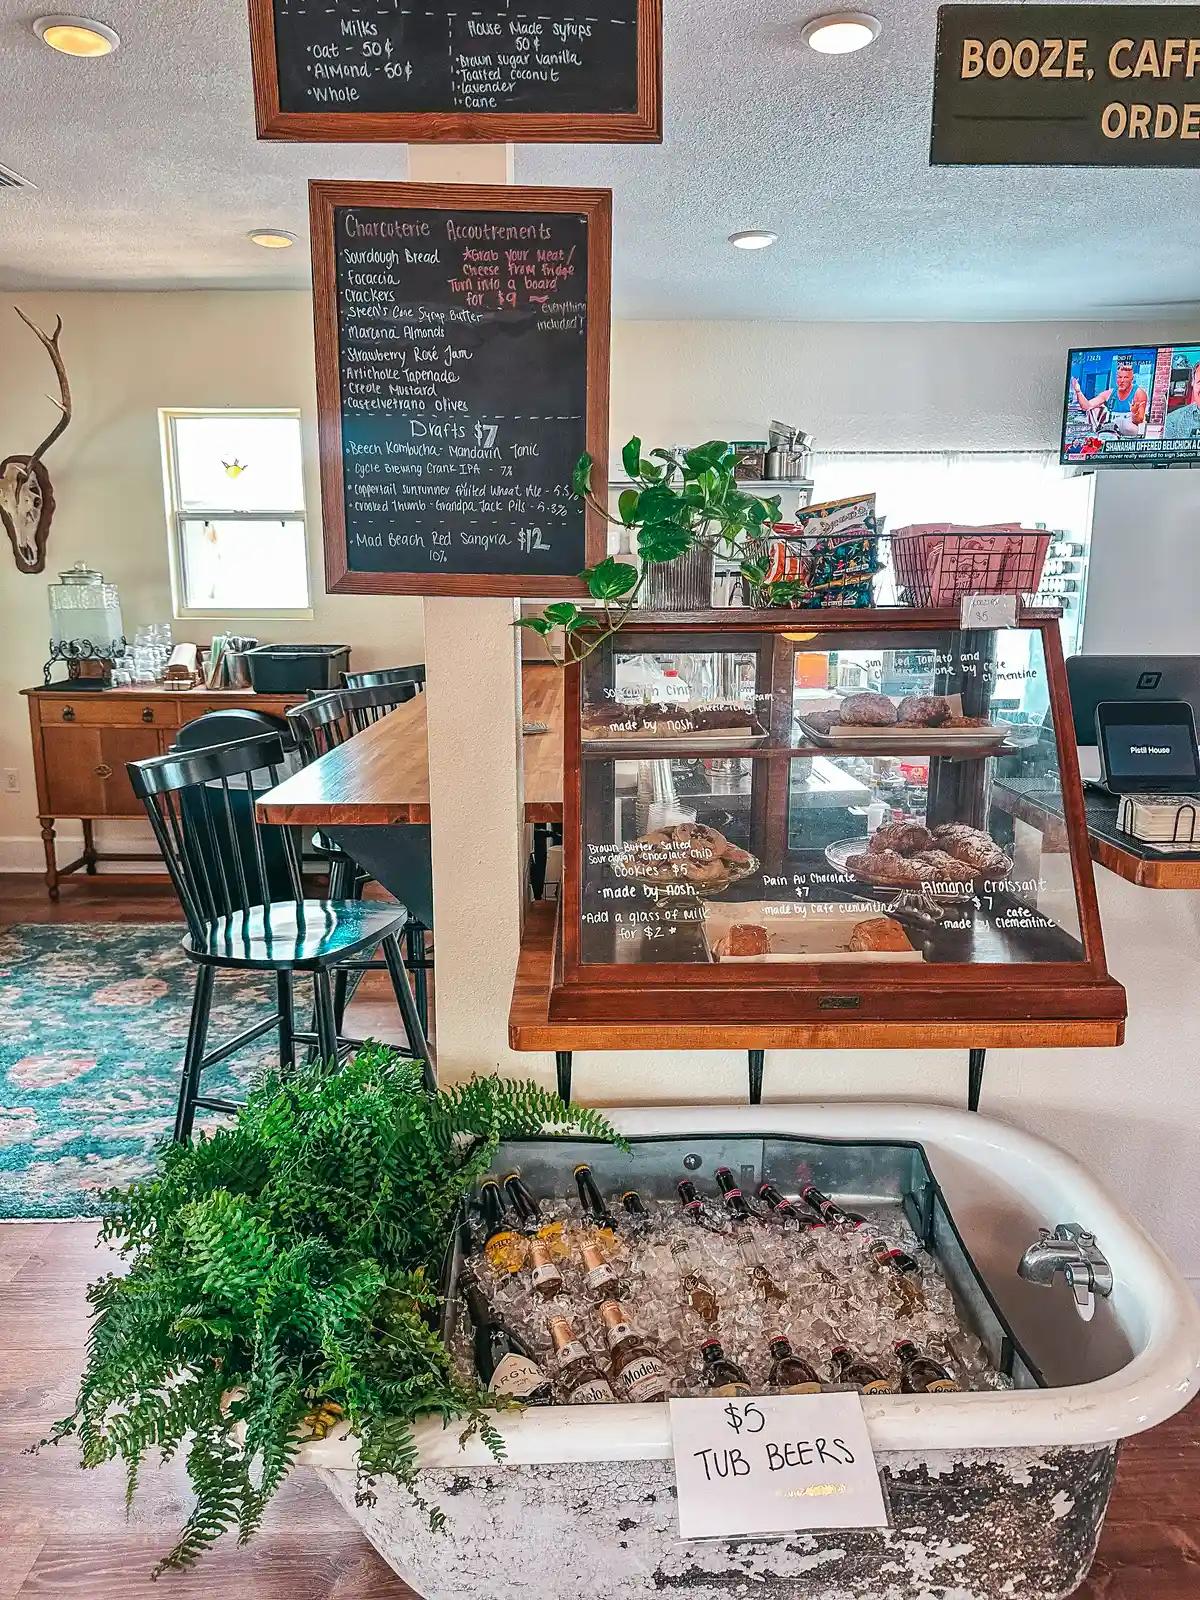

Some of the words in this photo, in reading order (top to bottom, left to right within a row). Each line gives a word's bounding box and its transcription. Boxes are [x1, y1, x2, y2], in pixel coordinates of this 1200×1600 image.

[340, 19, 378, 38] Milks
[467, 20, 502, 37] House
[508, 20, 543, 36] Made
[312, 43, 340, 59] Oat
[459, 54, 493, 68] Brown
[961, 38, 1095, 82] BOOZE,
[312, 86, 360, 102] Whole
[464, 96, 498, 108] Cane
[446, 219, 552, 241] Accoutrements
[343, 247, 400, 270] Sourdough
[404, 247, 441, 265] Bread
[347, 269, 401, 286] Focaccia
[462, 263, 500, 276] Cheese
[508, 260, 536, 276] from
[541, 262, 575, 281] fridge
[447, 277, 473, 293] Turn
[477, 277, 501, 291] into
[507, 279, 517, 291] a
[524, 276, 558, 292] board
[344, 287, 396, 303] Crackers
[465, 291, 484, 307] for
[497, 290, 517, 308] $9
[449, 309, 483, 324] Butter
[403, 325, 445, 340] Almonds
[347, 346, 406, 368] Strawberry
[444, 344, 473, 366] Jam
[346, 366, 401, 380] Artichoke
[402, 367, 461, 384] Tapenade
[348, 382, 382, 395] Creole
[388, 383, 438, 397] Mustard
[347, 397, 426, 411] Castelvetrano
[409, 419, 466, 440] Drafts
[474, 420, 499, 449] $7
[448, 445, 502, 460] Mandarin
[509, 442, 540, 459] Tonic
[1105, 440, 1136, 451] SHANAHAN
[1136, 440, 1162, 451] OFFERED
[1162, 439, 1192, 450] BELICHICK
[384, 463, 422, 477] Brewing
[458, 463, 481, 476] IPA
[435, 499, 477, 515] Grandpa
[479, 499, 504, 512] Jack
[508, 499, 526, 513] Pils
[356, 532, 384, 548] Mad
[388, 531, 426, 548] Beach
[431, 530, 452, 547] Red
[517, 527, 551, 554] $12
[429, 549, 448, 563] 10%
[915, 653, 953, 666] Tomato
[960, 651, 980, 662] and
[961, 663, 977, 677] by
[609, 721, 637, 732] made
[643, 719, 658, 734] by
[1130, 746, 1147, 754] Pistil
[1148, 746, 1170, 754] House
[587, 843, 619, 855] Brown
[763, 874, 788, 886] Pain
[810, 872, 857, 884] Chocolate
[921, 878, 974, 895] Almond
[602, 884, 636, 899] made
[643, 883, 660, 902] by
[795, 886, 810, 898] $7
[764, 903, 792, 916] made
[793, 902, 807, 918] by
[971, 895, 993, 911] $7
[614, 913, 623, 923] a
[629, 910, 660, 927] glass
[664, 909, 679, 920] of
[943, 918, 972, 930] made
[618, 928, 638, 940] for
[643, 925, 665, 941] $2
[622, 1361, 661, 1387] Modelo
[724, 1402, 766, 1435] $5
[693, 1448, 751, 1480] TUB
[765, 1437, 855, 1472] BEERS
